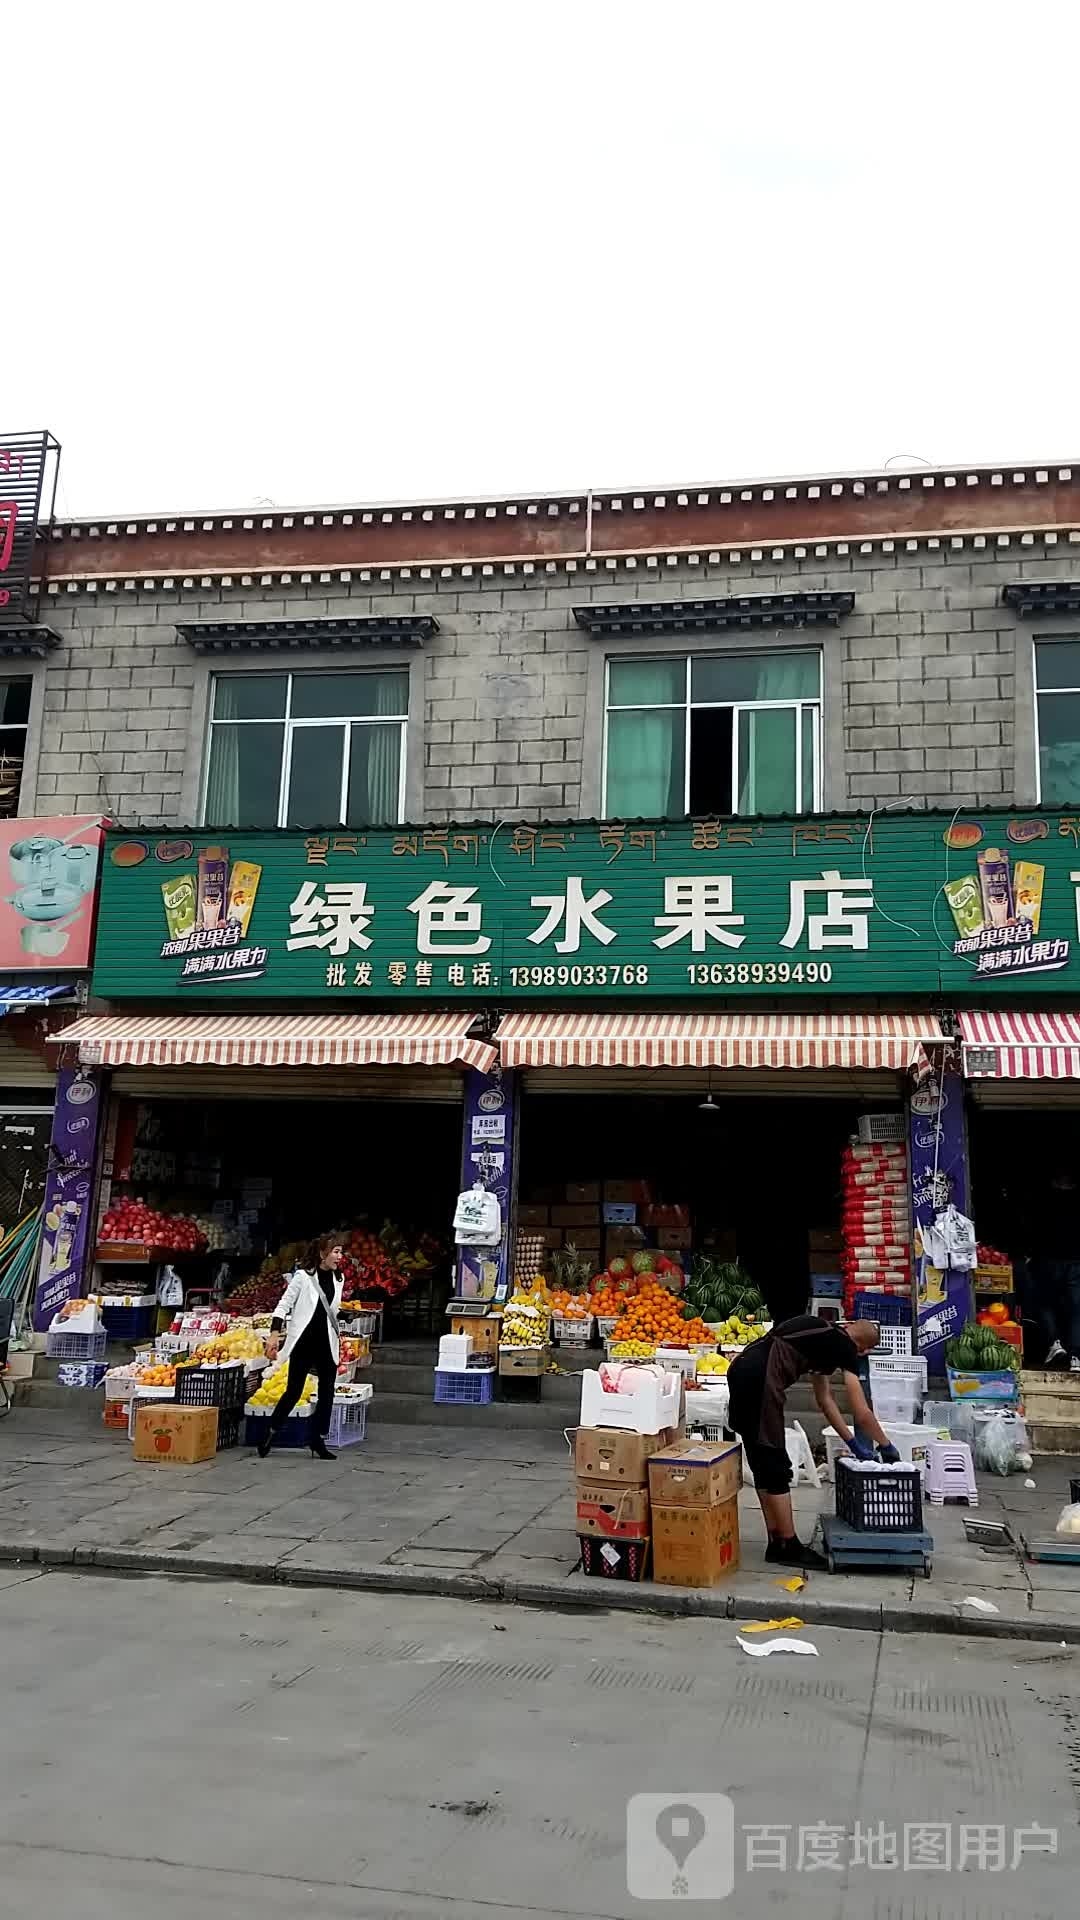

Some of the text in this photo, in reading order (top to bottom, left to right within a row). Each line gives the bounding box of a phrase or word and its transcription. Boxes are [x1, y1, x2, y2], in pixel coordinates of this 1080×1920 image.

[286, 869, 874, 956] 绿色水果店
[160, 925, 242, 957] 浓郁果果昔
[953, 922, 1034, 954] 浓郁果果昔
[181, 946, 268, 976] 满满水果力
[976, 938, 1070, 972] 满满水果力
[326, 961, 373, 986] 批发
[387, 961, 433, 986] 零售
[509, 964, 649, 987] 13989033768
[686, 961, 833, 985] 13638939490
